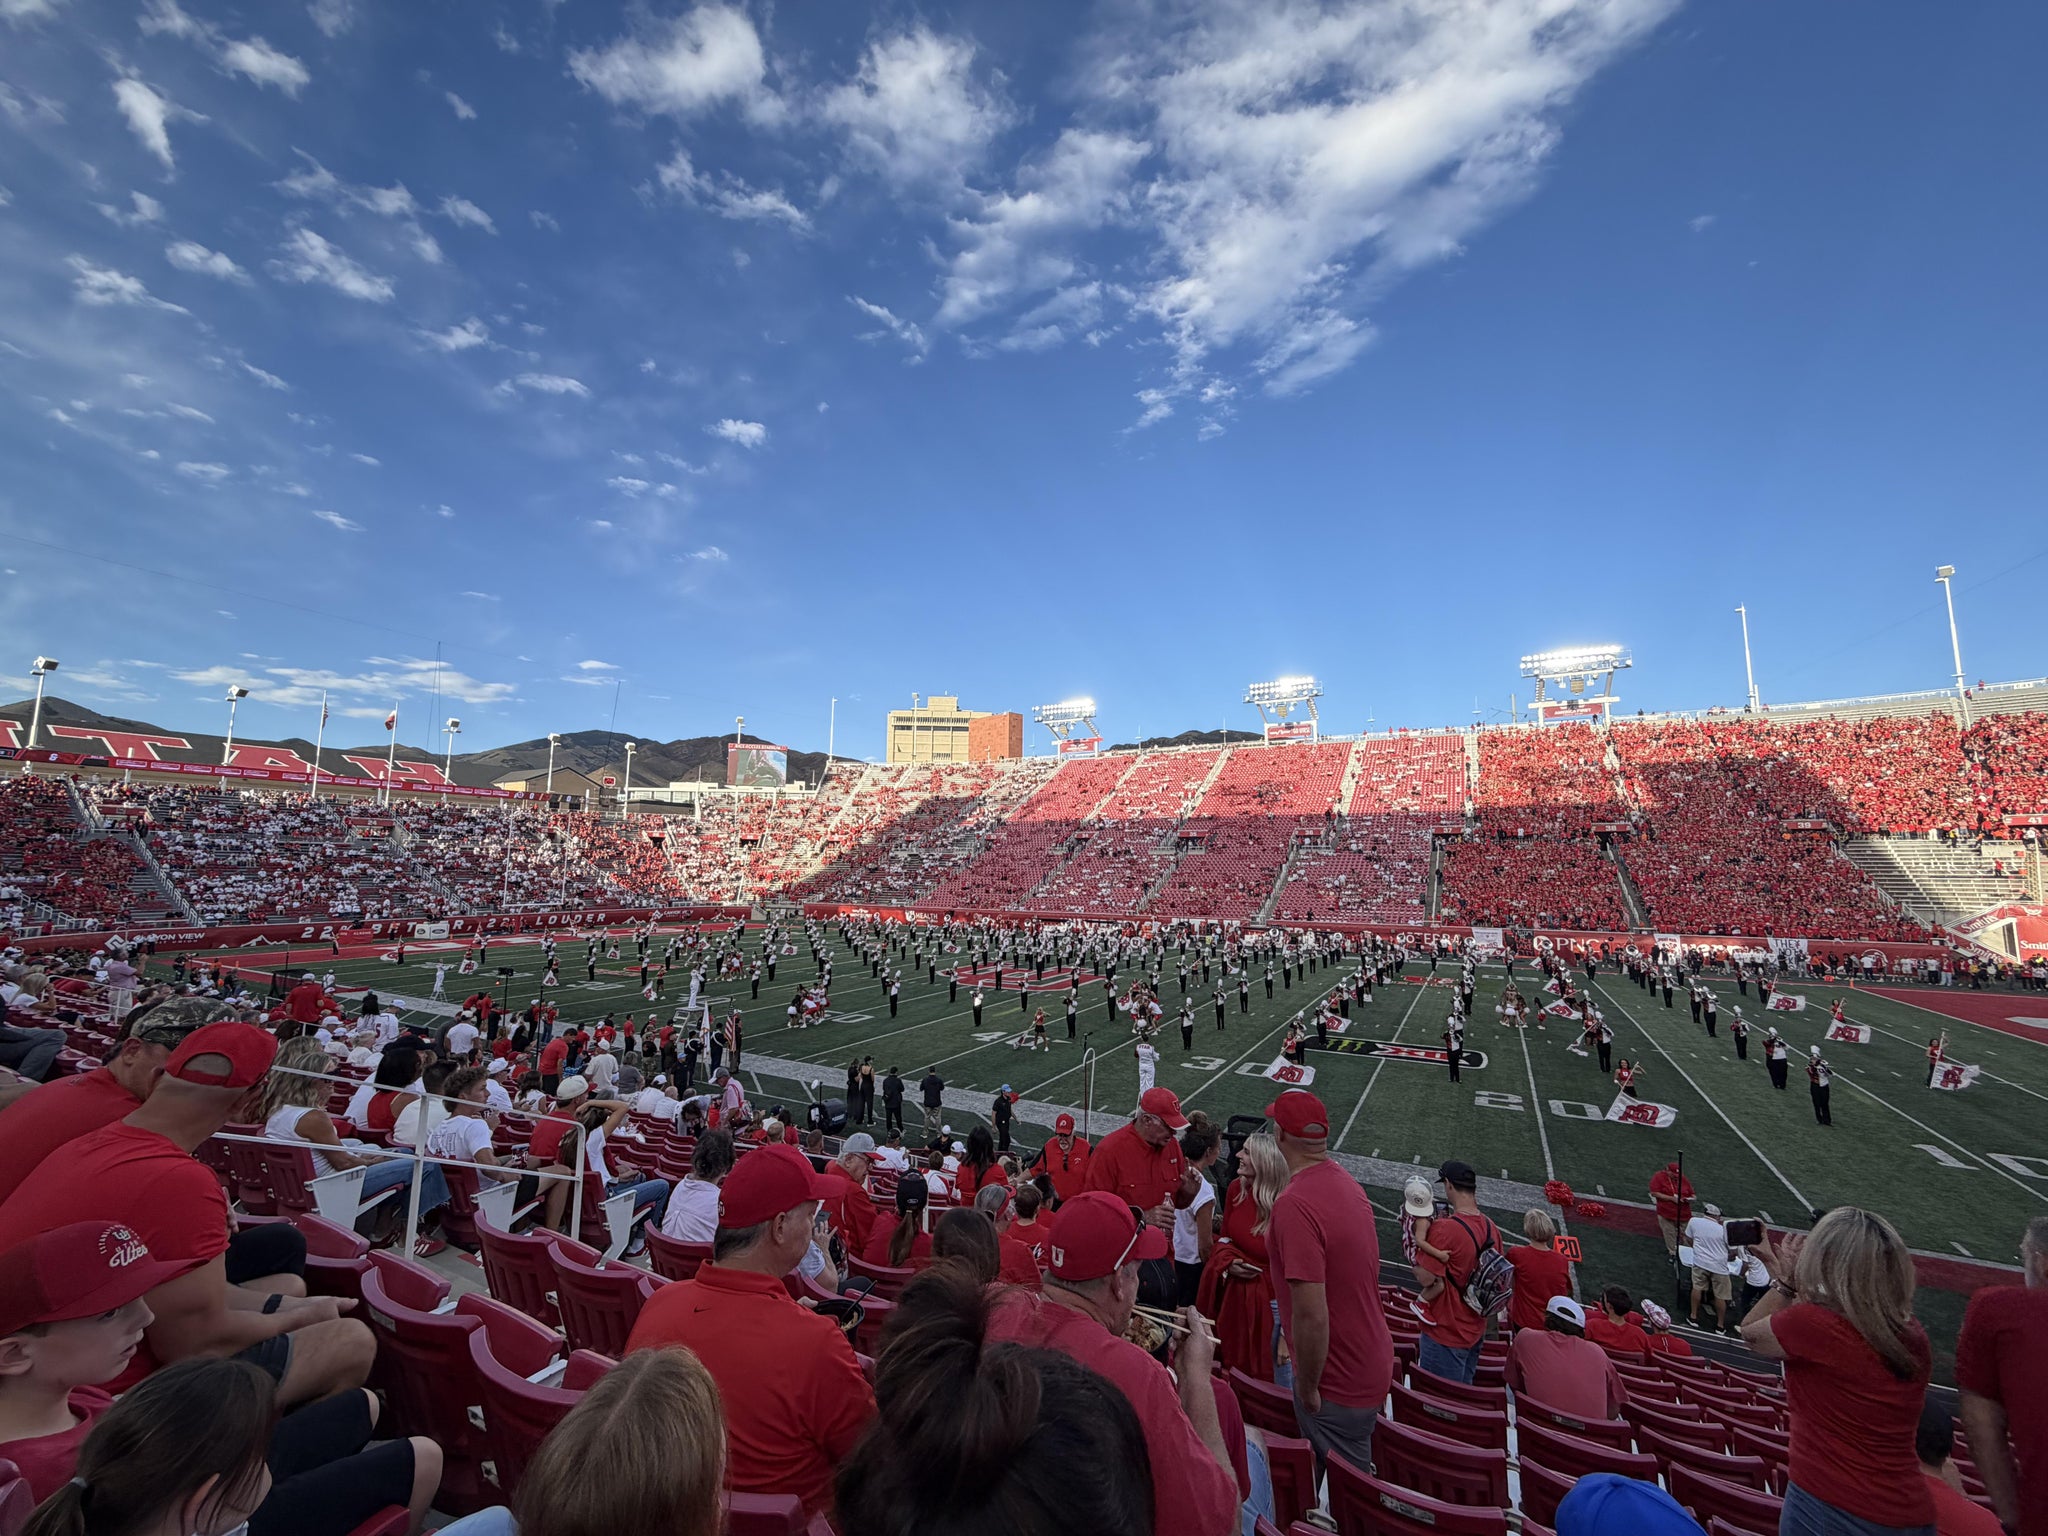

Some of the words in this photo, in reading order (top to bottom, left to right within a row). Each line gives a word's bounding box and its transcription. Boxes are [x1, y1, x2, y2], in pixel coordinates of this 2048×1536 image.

[1797, 821, 1812, 829] 39
[2027, 816, 2043, 824] 41
[535, 913, 606, 926] LOUDER
[109, 1245, 148, 1267] Utes
[1557, 1238, 1580, 1258] 20
[1051, 1245, 1065, 1268] U
